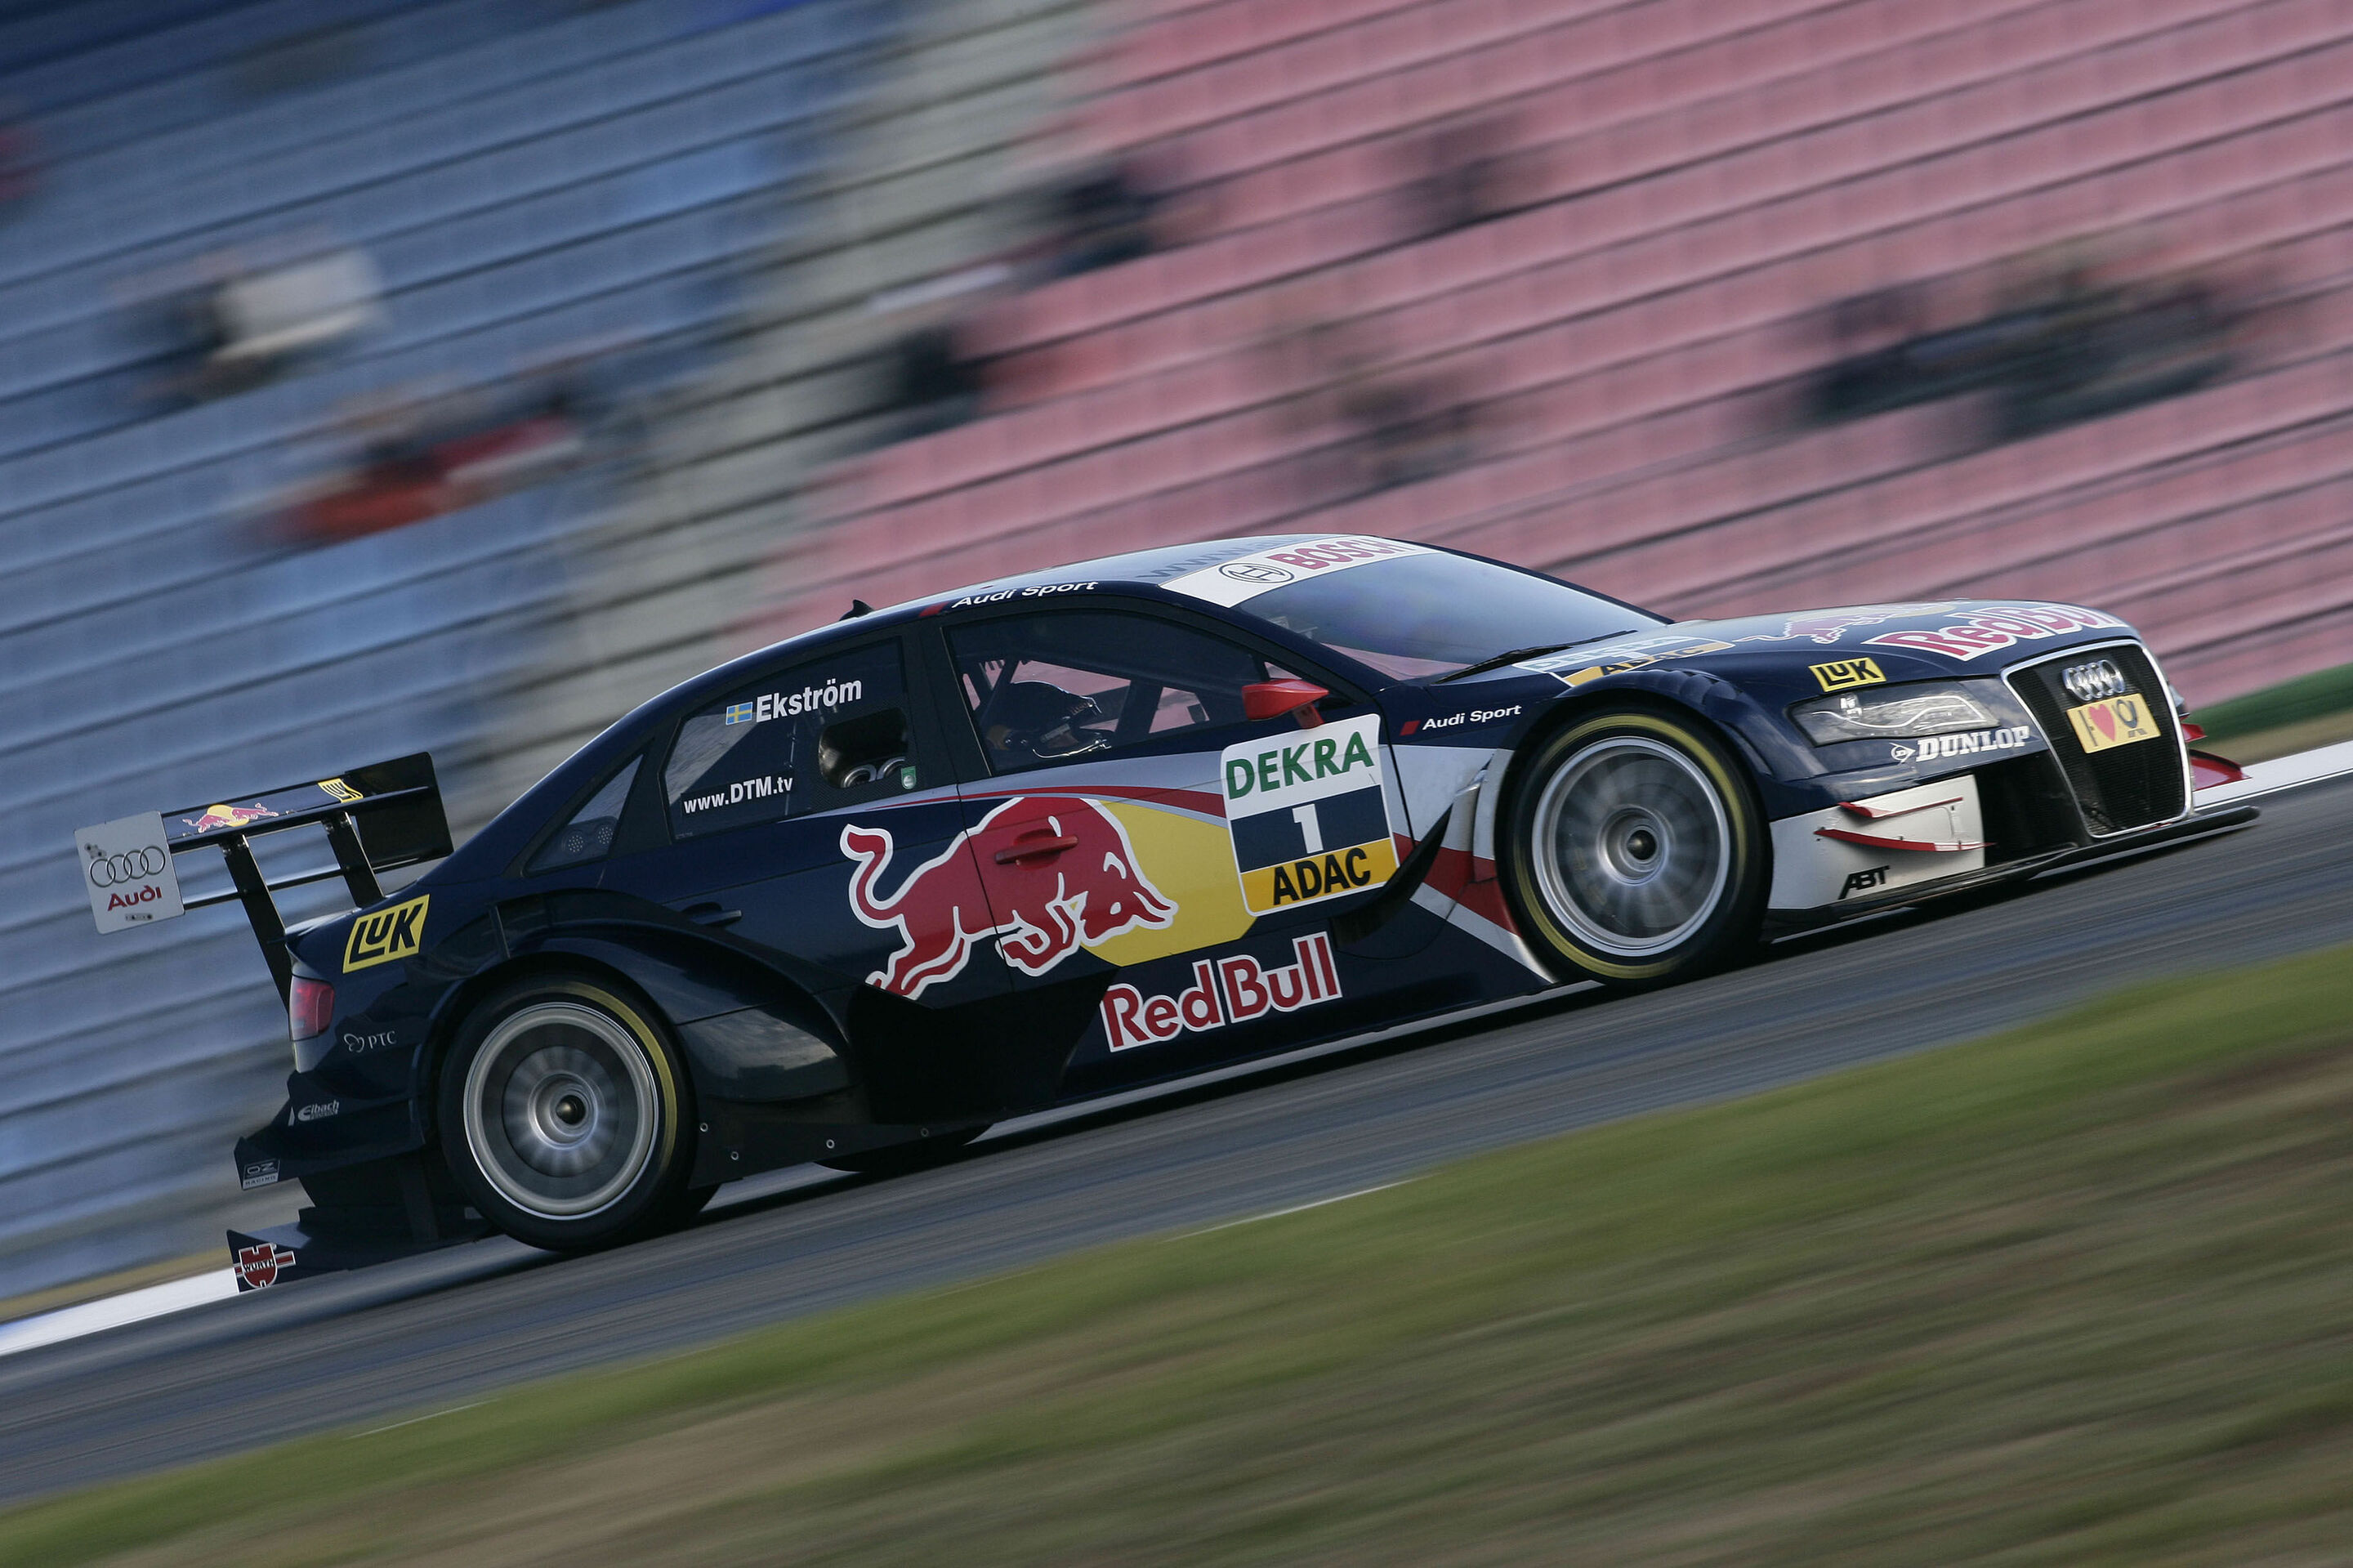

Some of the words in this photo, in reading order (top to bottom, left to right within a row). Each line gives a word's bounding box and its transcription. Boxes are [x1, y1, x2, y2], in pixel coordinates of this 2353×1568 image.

[1266, 538, 1418, 570] BOSCH
[951, 588, 1017, 609] Audi
[1021, 581, 1099, 597] Sport
[756, 677, 863, 723] Ekström
[1422, 713, 1466, 730] Audi
[1469, 704, 1522, 723] Sport
[1915, 725, 2030, 762] DUNLOP
[1226, 730, 1375, 801] DEKRA
[683, 775, 794, 814] www.DTM.tv
[1291, 802, 1324, 854] 1
[1272, 847, 1372, 906] ADAC
[1837, 864, 1891, 900] ABT
[107, 884, 163, 912] Audi
[368, 1030, 398, 1050] PTC
